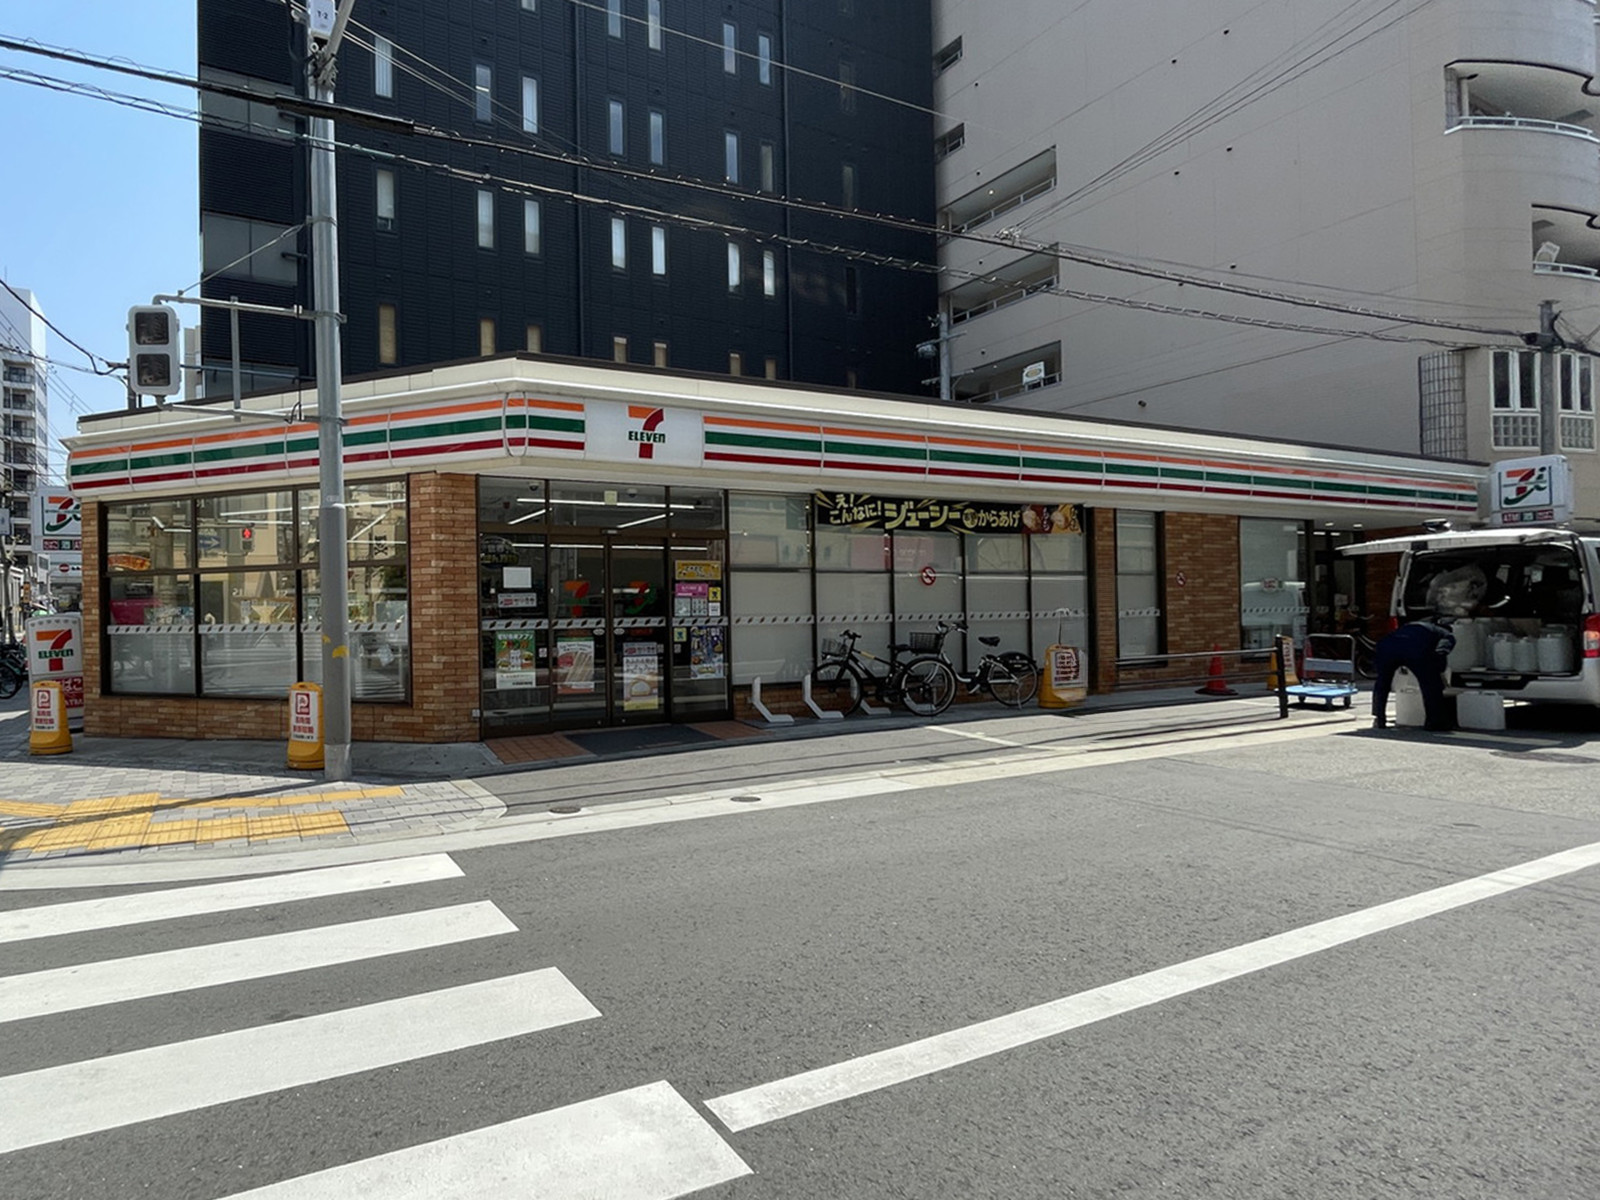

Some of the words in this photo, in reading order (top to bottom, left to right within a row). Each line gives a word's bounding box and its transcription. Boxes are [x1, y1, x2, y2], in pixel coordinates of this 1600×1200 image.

[884, 500, 960, 530] ジューシー
[978, 509, 1020, 528] からあげ
